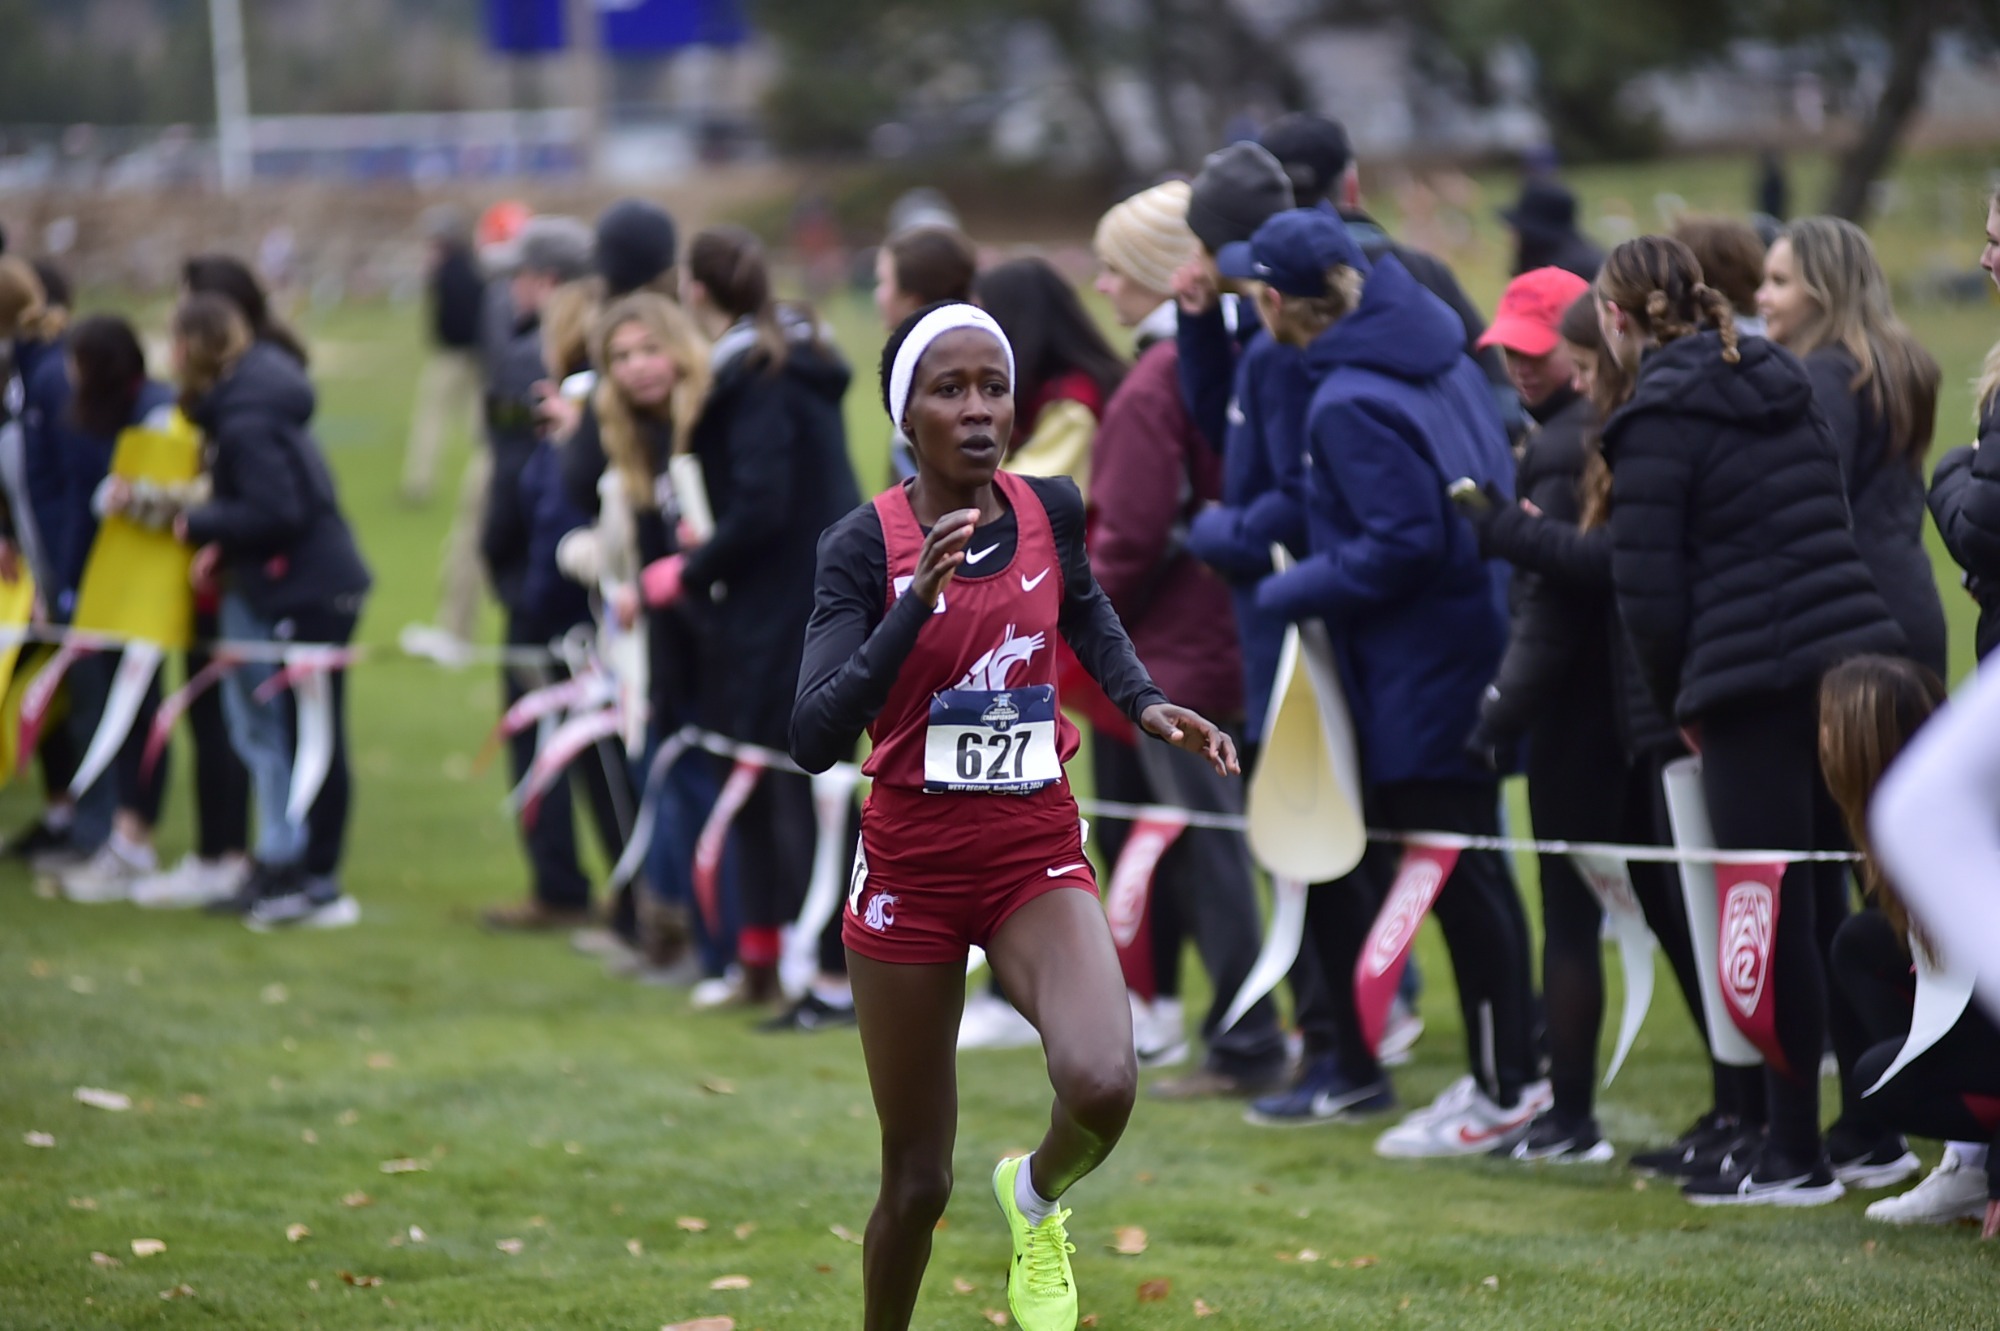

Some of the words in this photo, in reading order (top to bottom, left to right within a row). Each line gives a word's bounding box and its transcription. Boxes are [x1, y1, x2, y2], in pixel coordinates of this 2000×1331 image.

[956, 730, 1032, 780] 627
[948, 783, 966, 791] WEST
[966, 784, 990, 792] REGION
[1732, 948, 1756, 989] 12
